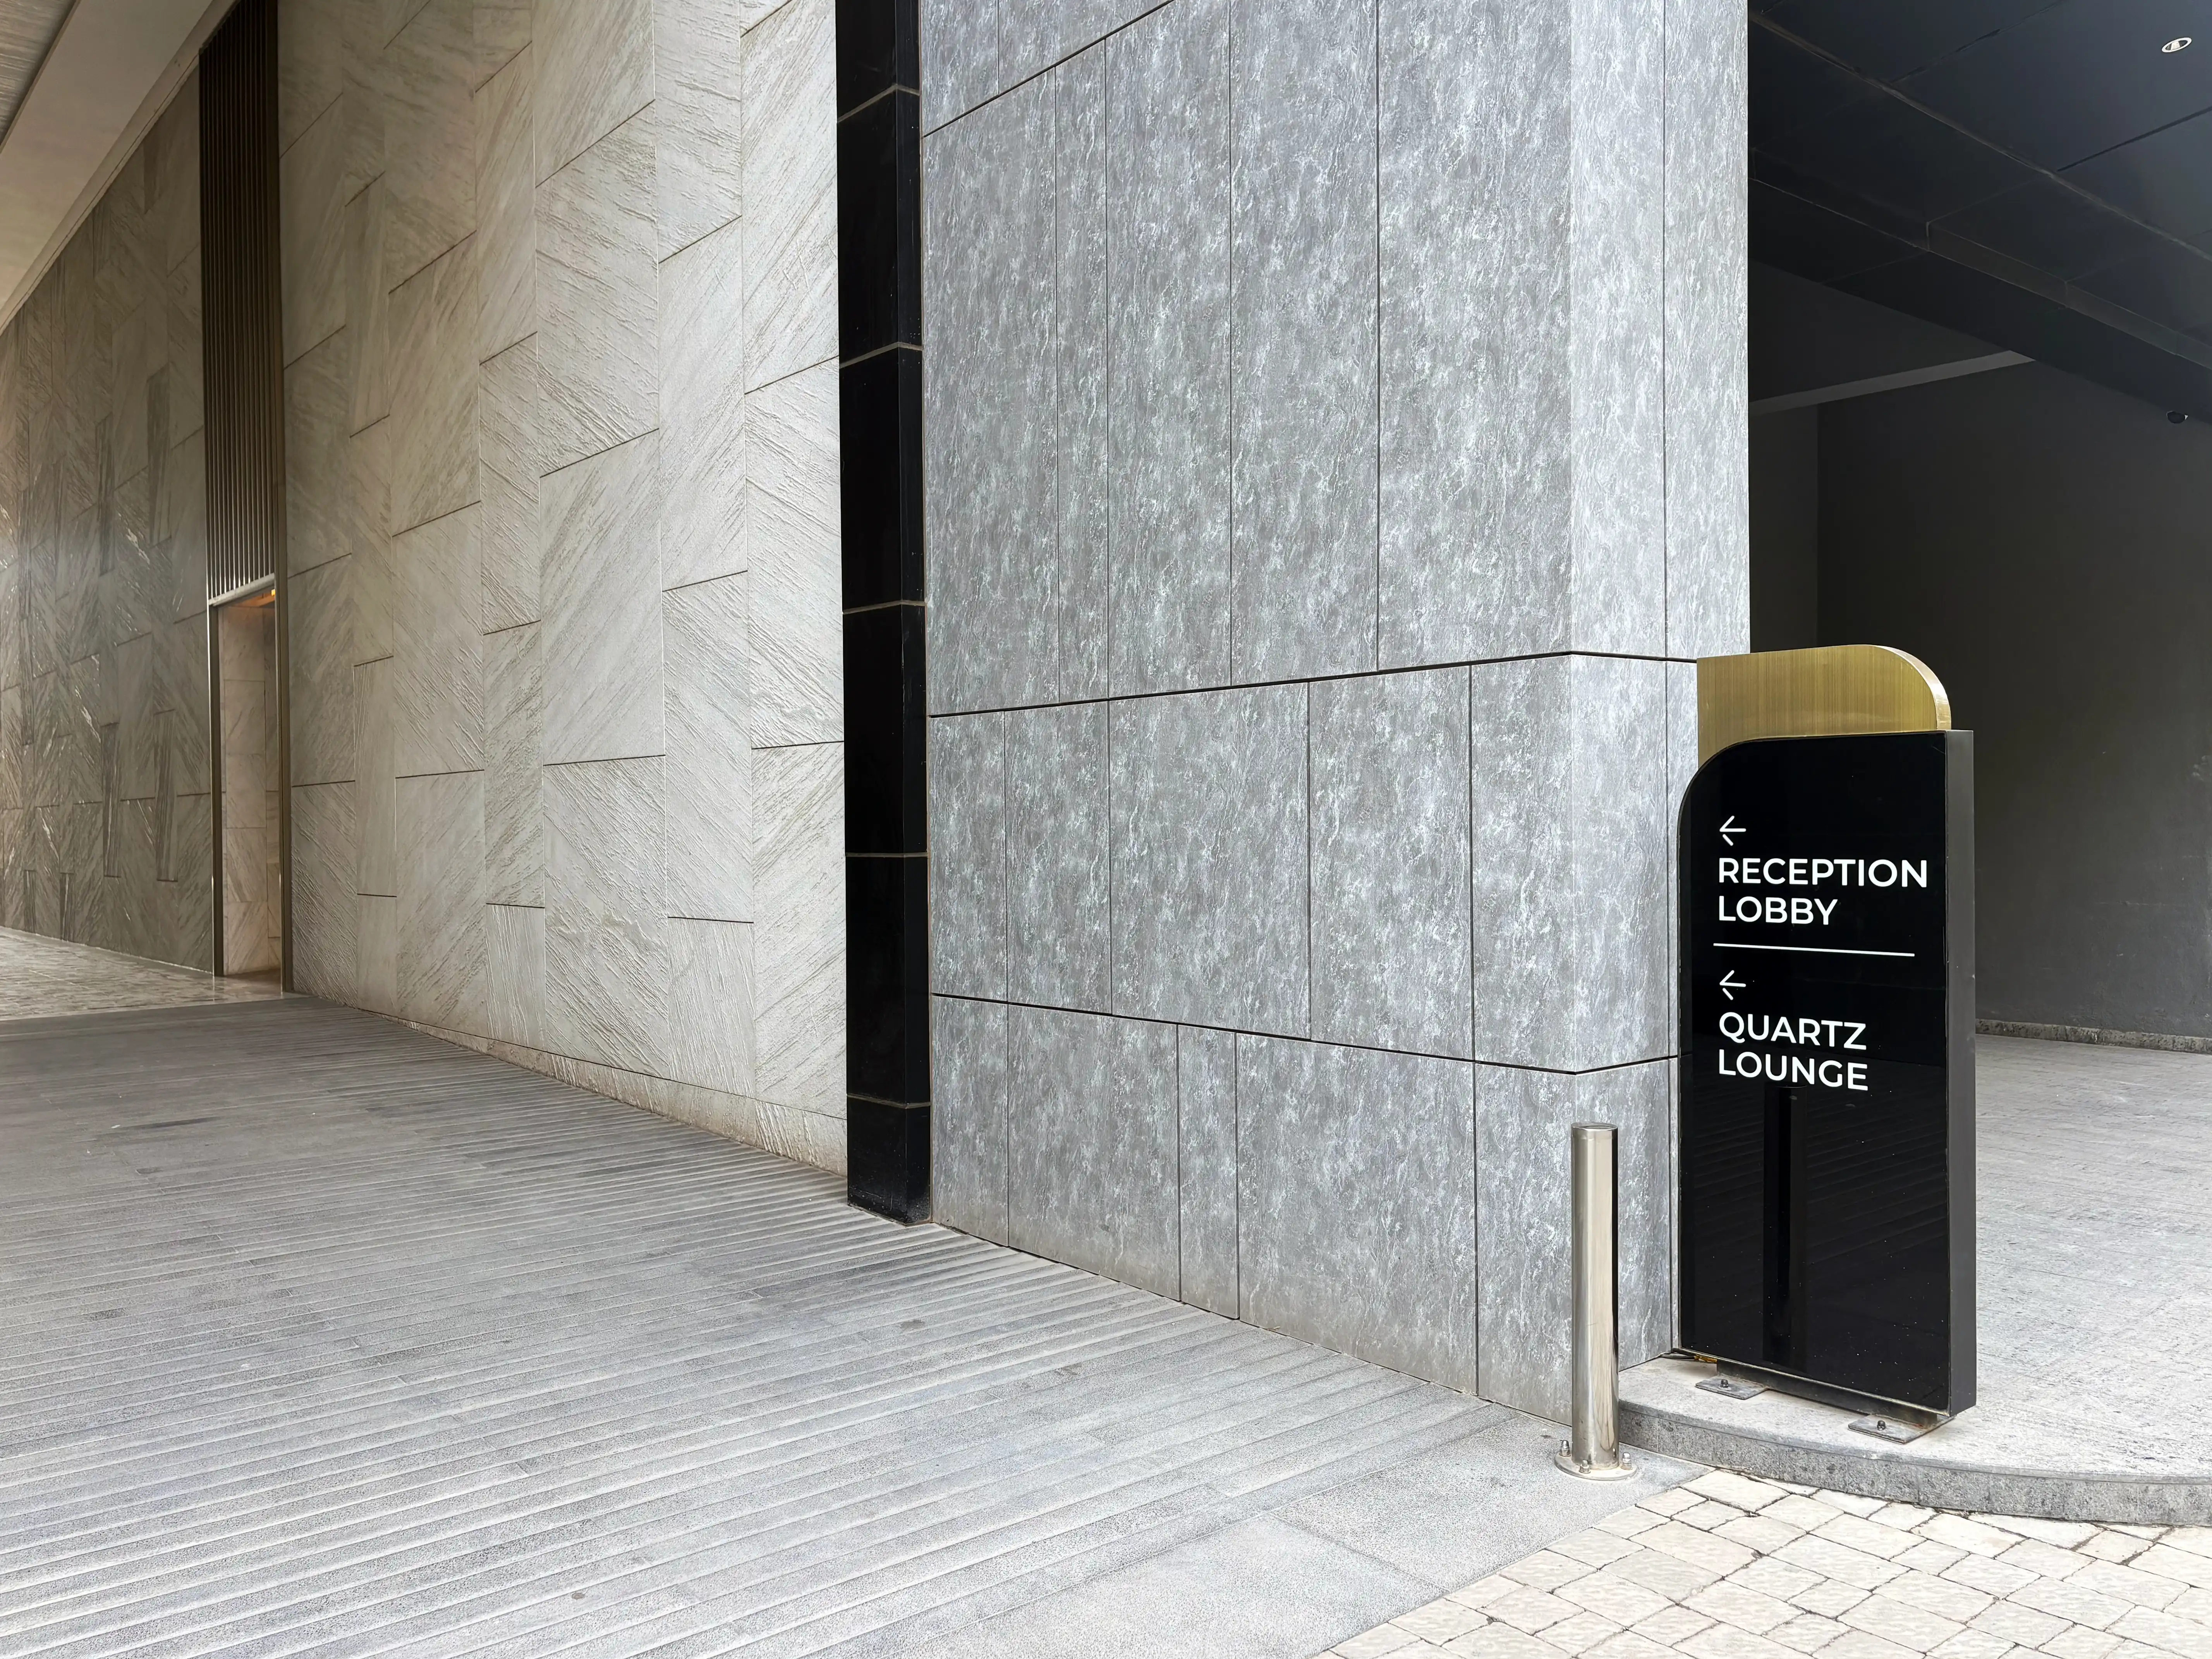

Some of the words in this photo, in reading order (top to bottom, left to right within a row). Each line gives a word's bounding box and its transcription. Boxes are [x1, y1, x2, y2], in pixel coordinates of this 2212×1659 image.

[1719, 857, 1927, 888] RECEPTION
[1719, 895, 1838, 926] LOBBY
[1719, 1012, 1867, 1051] QUARTZ
[1719, 1049, 1869, 1091] LOUNGE
